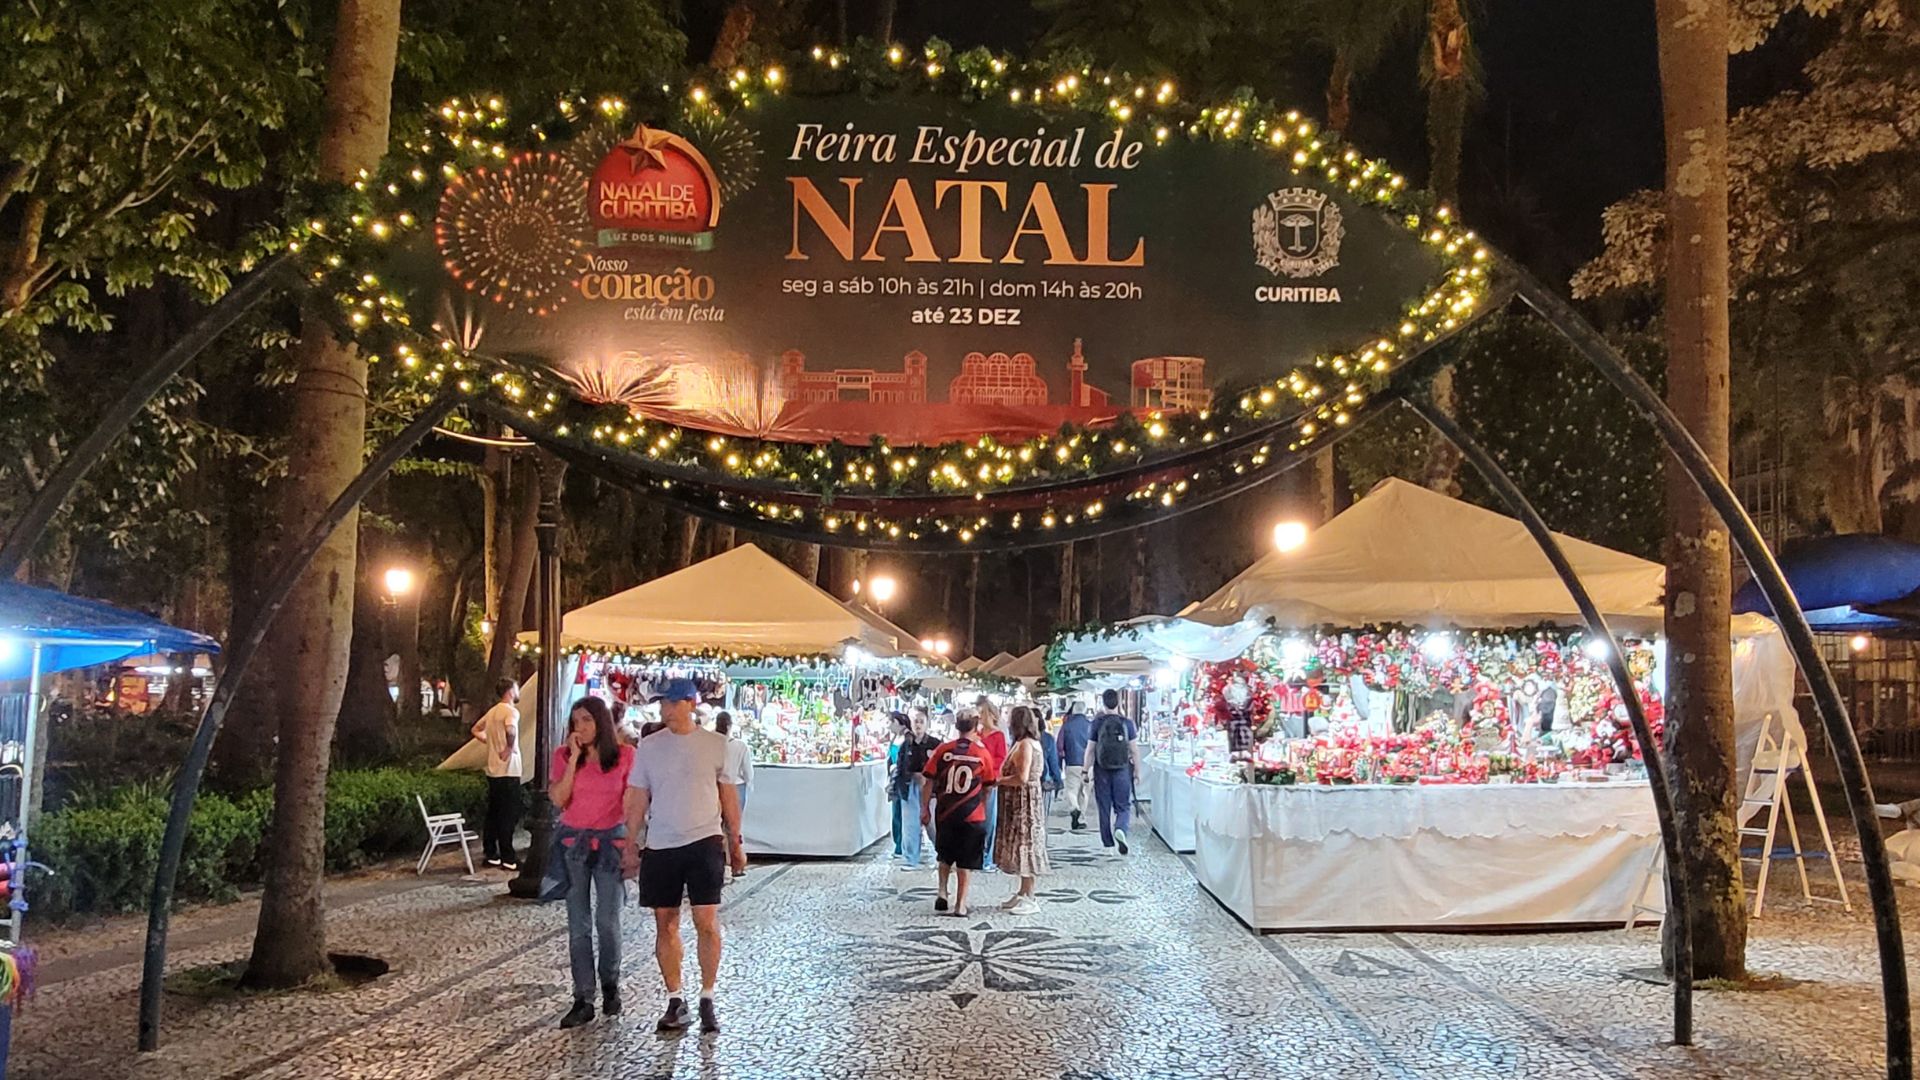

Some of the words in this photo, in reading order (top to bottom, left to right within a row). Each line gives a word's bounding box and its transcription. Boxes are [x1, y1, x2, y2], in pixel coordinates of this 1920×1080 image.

[787, 121, 897, 163] Feira
[908, 124, 1082, 174] Especial
[1094, 127, 1144, 170] de
[600, 181, 670, 200] NATAL
[670, 184, 694, 202] DE
[600, 200, 698, 219] CURITIBA
[784, 176, 1145, 267] NATAL
[607, 232, 628, 241] LUZ
[631, 233, 655, 242] DOS
[658, 234, 703, 246] PINHAIS
[578, 253, 629, 274] Nosso
[580, 266, 715, 306] coração
[782, 278, 818, 297] seg
[822, 280, 834, 293] a
[838, 276, 875, 294] sáb
[878, 277, 912, 295] 10h
[916, 277, 939, 295] às
[942, 277, 975, 296] 21h
[989, 279, 1036, 297] dom
[1040, 280, 1074, 298] 14h
[1079, 280, 1101, 299] às
[1104, 281, 1142, 300] 20h
[1255, 286, 1341, 303] CURITIBA
[624, 302, 657, 321] está
[659, 307, 684, 321] em
[686, 303, 725, 324] festa
[911, 306, 945, 324] até
[949, 307, 973, 324] 23
[978, 308, 1021, 325] DEZ
[945, 764, 973, 794] 10
